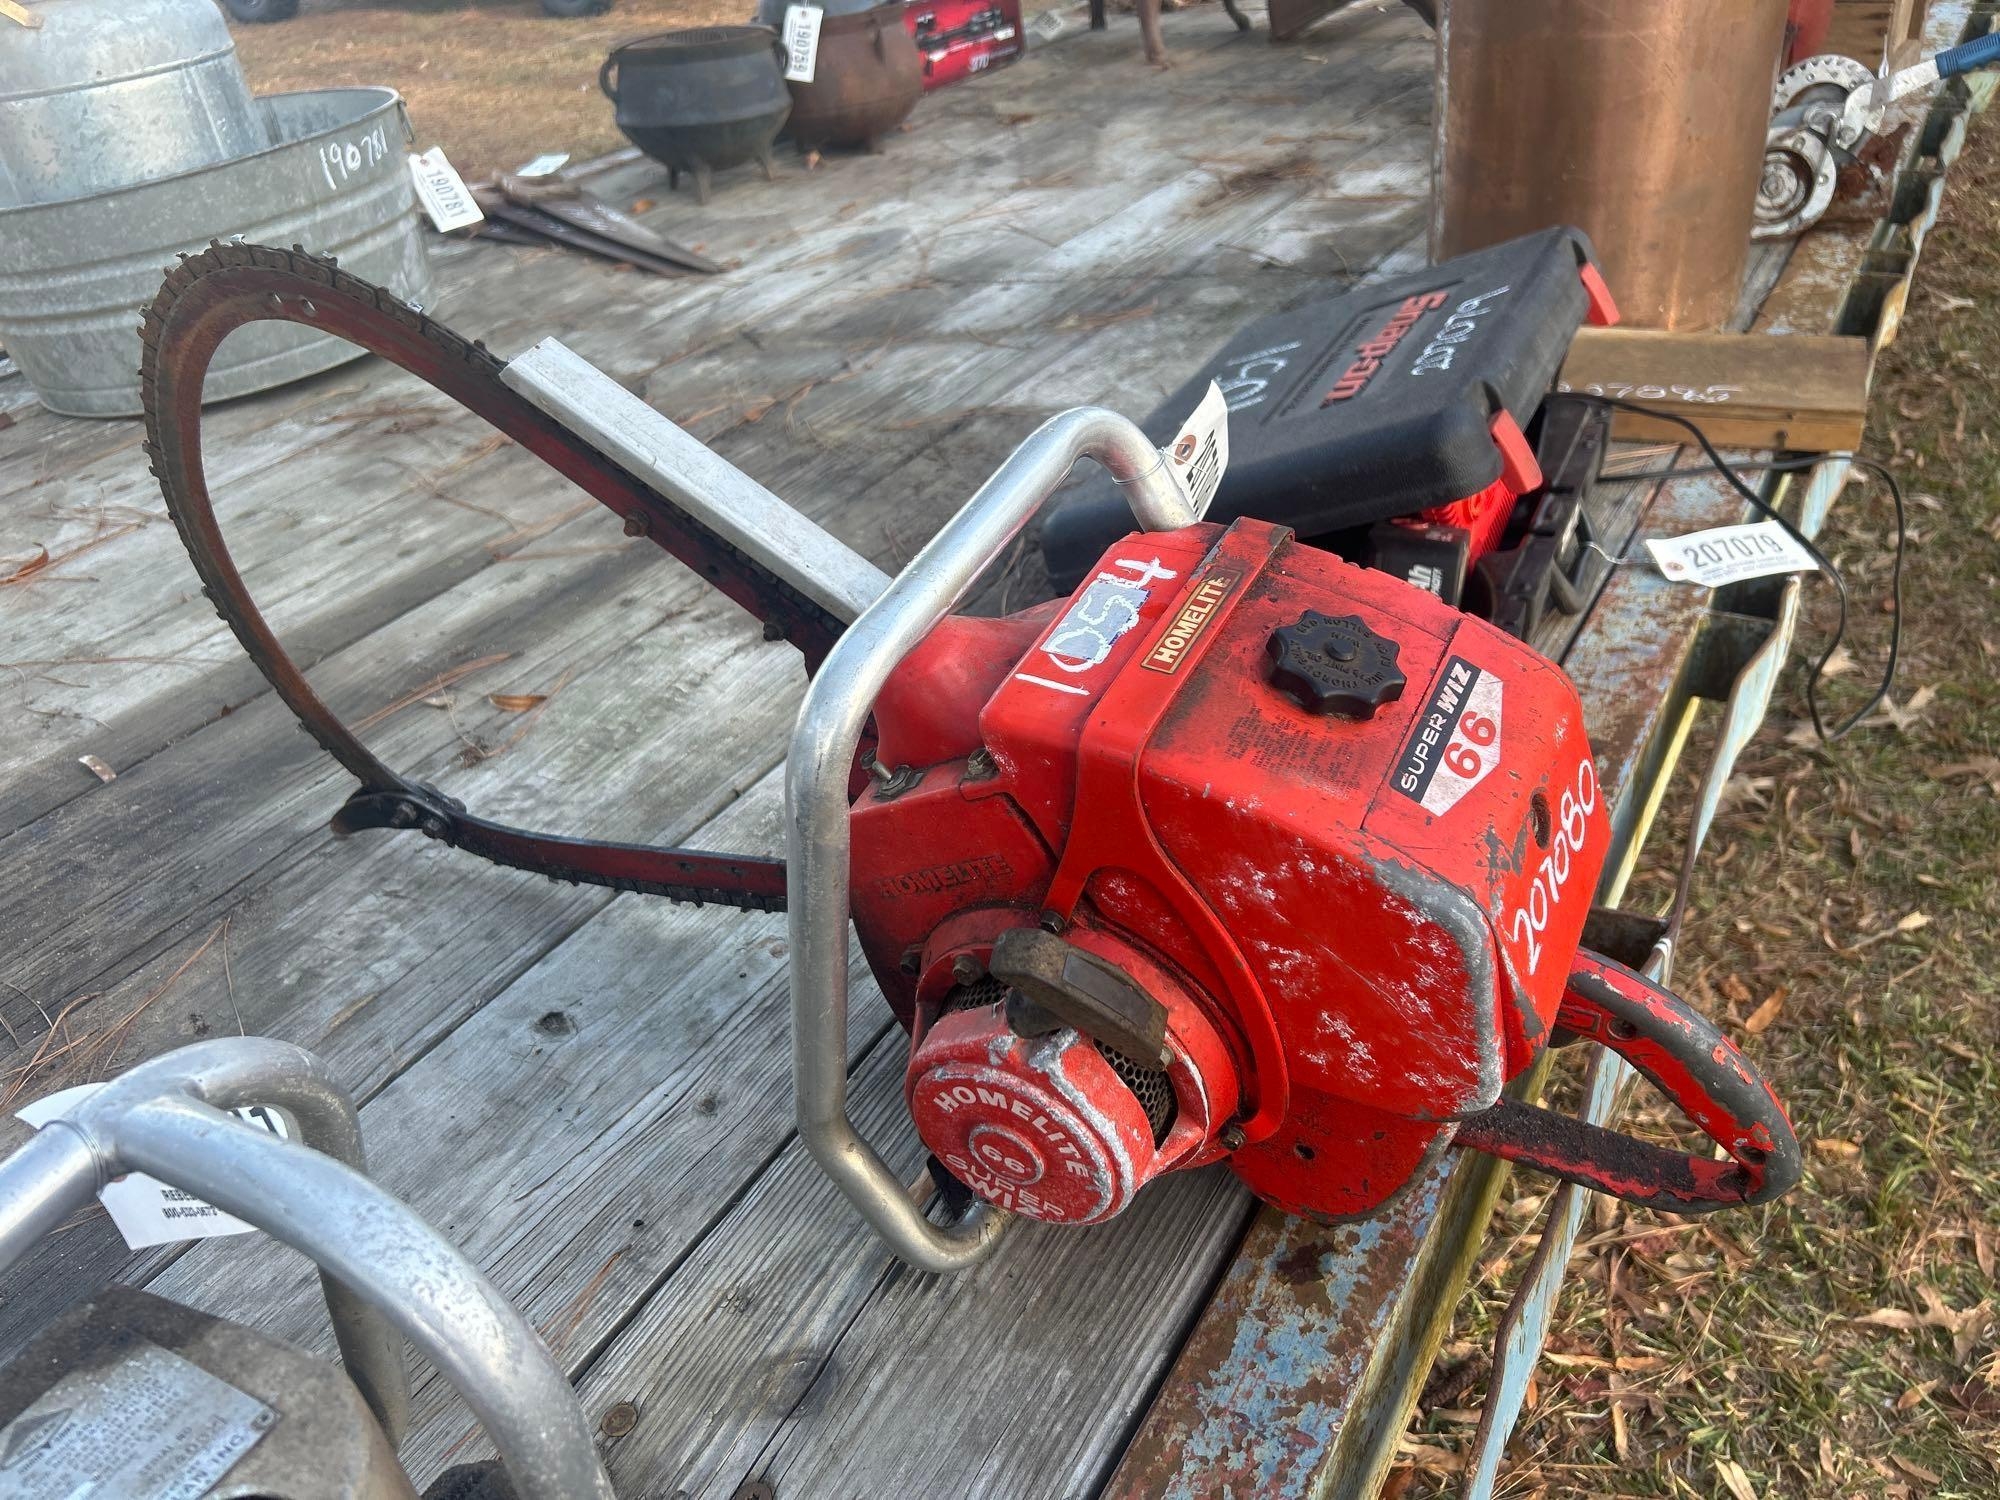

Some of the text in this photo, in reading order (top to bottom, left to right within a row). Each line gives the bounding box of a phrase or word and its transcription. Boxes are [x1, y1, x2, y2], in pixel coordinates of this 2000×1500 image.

[319, 125, 389, 191] 190781
[427, 168, 470, 218] 190781
[1683, 532, 1784, 569] 207079
[1014, 556, 1178, 697] 1054
[1153, 575, 1232, 665] HOMELITE
[1400, 662, 1472, 793] SUPER WIZ
[1443, 709, 1498, 780] 66
[880, 855, 1014, 897] HOMELITE
[1512, 758, 1595, 976] 207080
[932, 1085, 1089, 1179] HOMELITE
[981, 1143, 1026, 1175] 66
